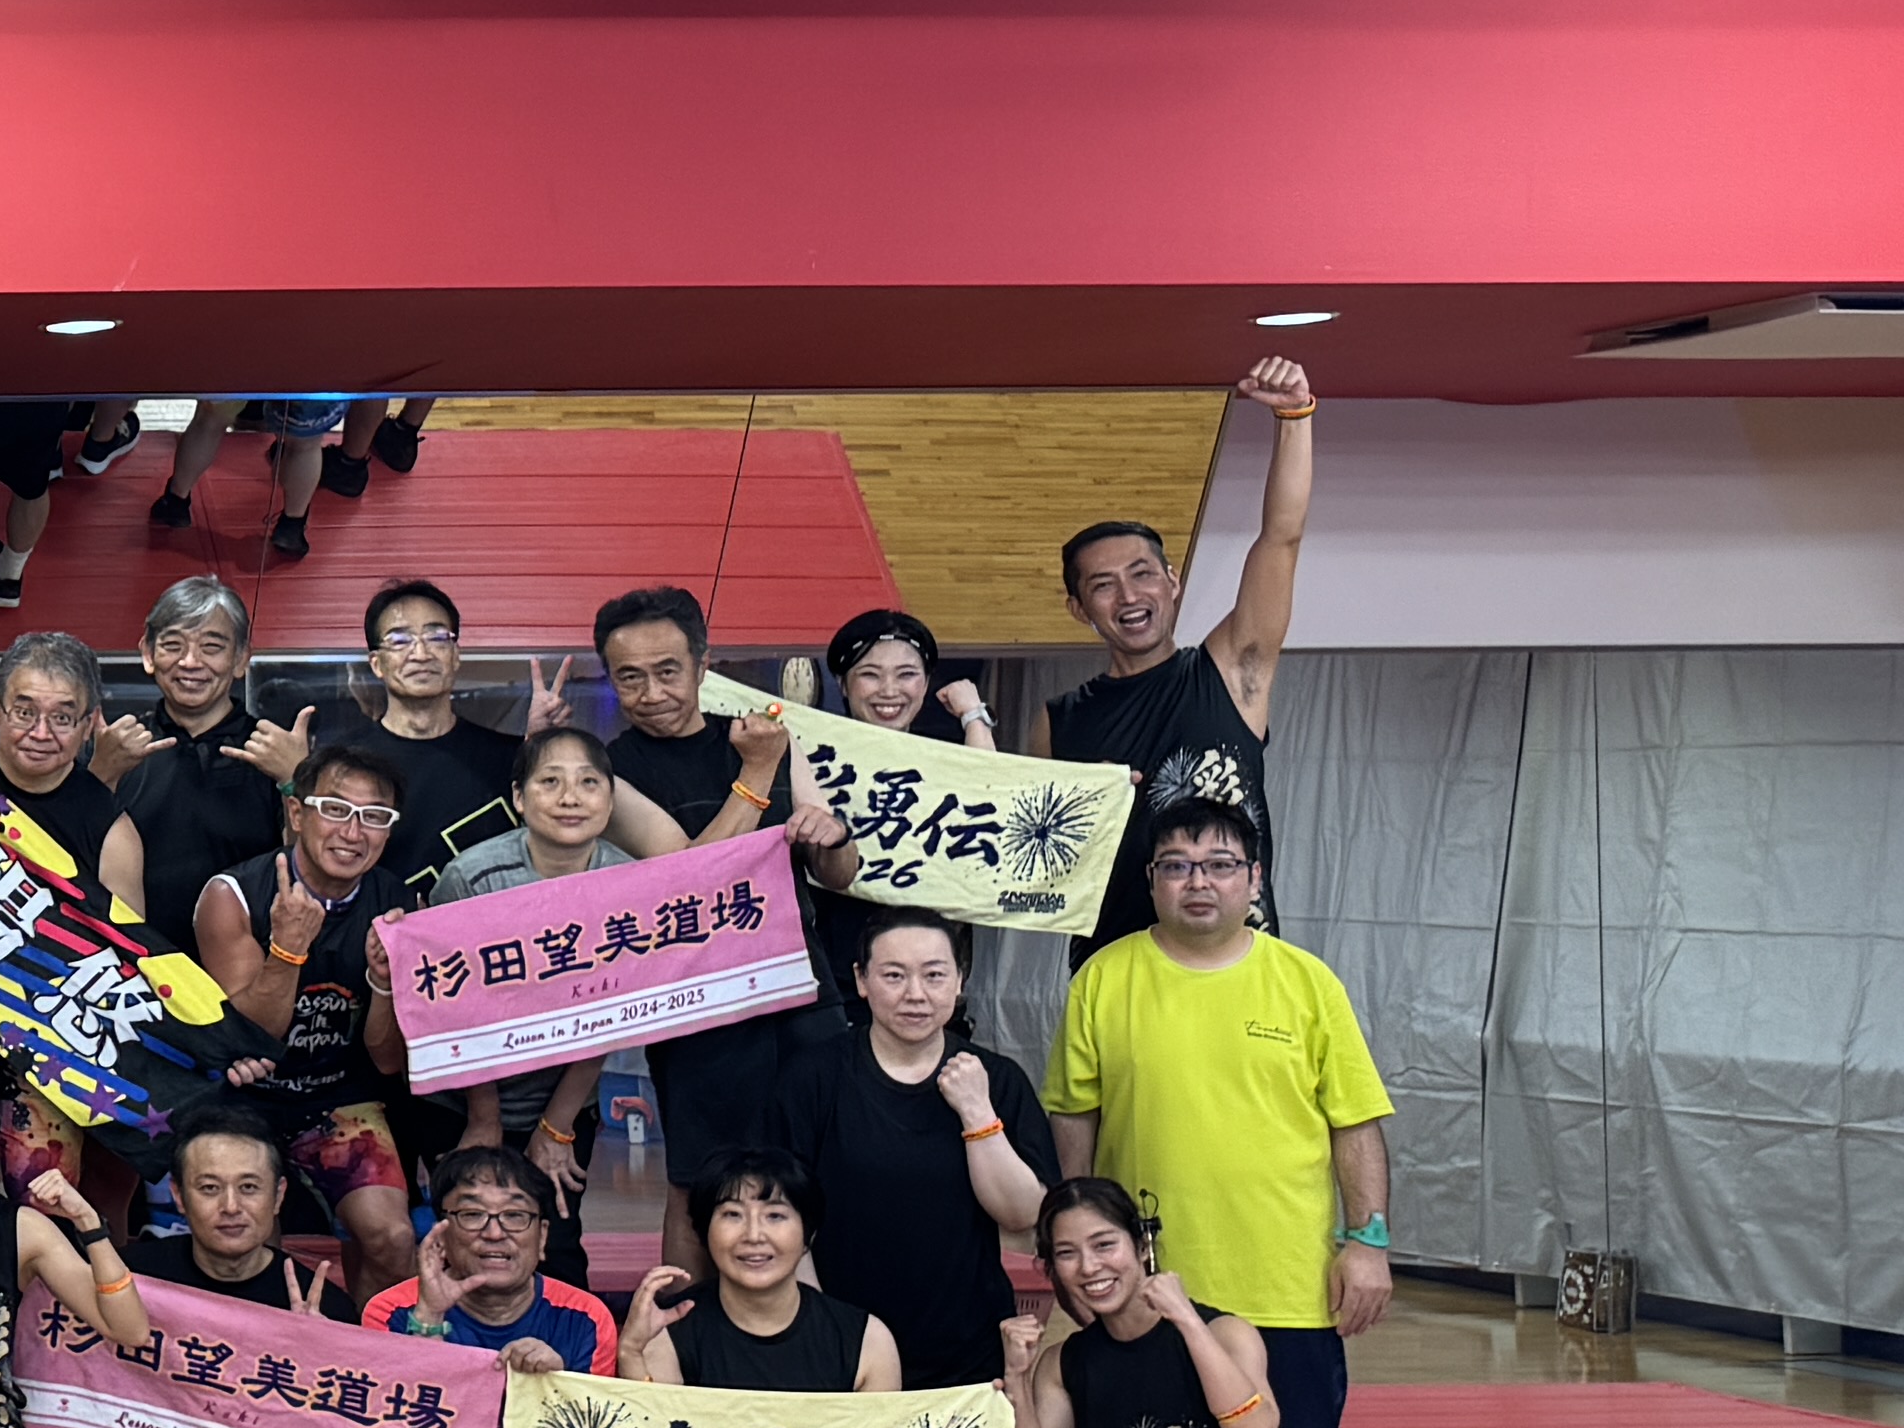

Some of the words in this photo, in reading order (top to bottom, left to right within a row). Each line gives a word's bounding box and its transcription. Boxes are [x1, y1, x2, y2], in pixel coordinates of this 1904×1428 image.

[858, 854, 925, 888] 26
[414, 878, 767, 1003] 杉田望美道場
[34, 949, 164, 1067] 悠
[503, 1032, 545, 1050] Lesson
[551, 1026, 566, 1040] in
[572, 1018, 613, 1037] Japan
[619, 988, 706, 1023] 2024-2025
